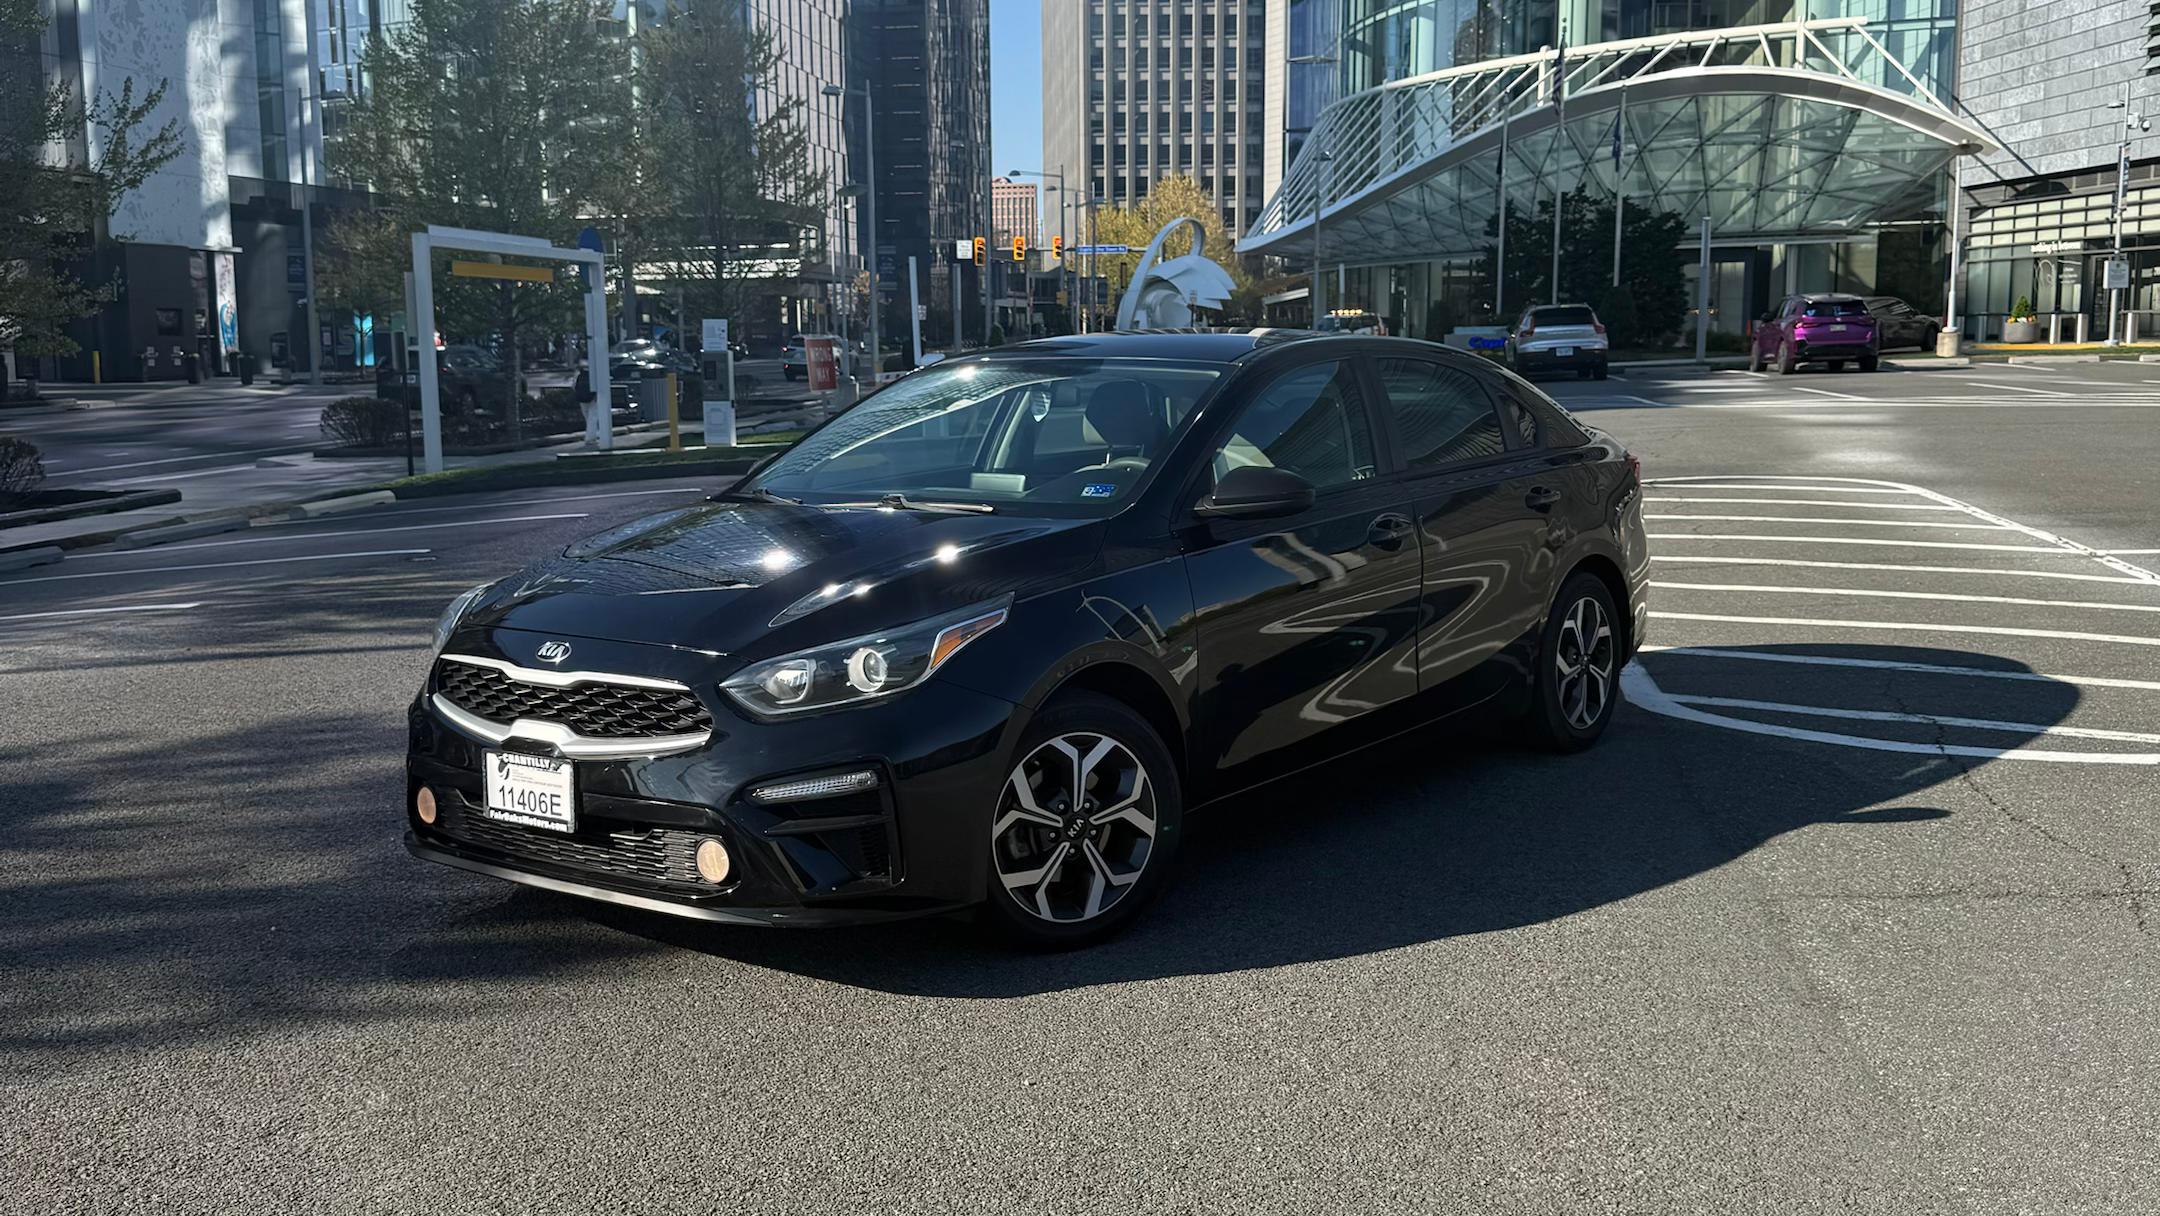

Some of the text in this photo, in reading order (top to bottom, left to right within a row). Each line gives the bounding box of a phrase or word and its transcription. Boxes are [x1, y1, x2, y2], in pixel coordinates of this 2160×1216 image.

[502, 753, 550, 768] CHANTILLY
[499, 785, 562, 816] 11406E
[1067, 819, 1084, 837] KIA
